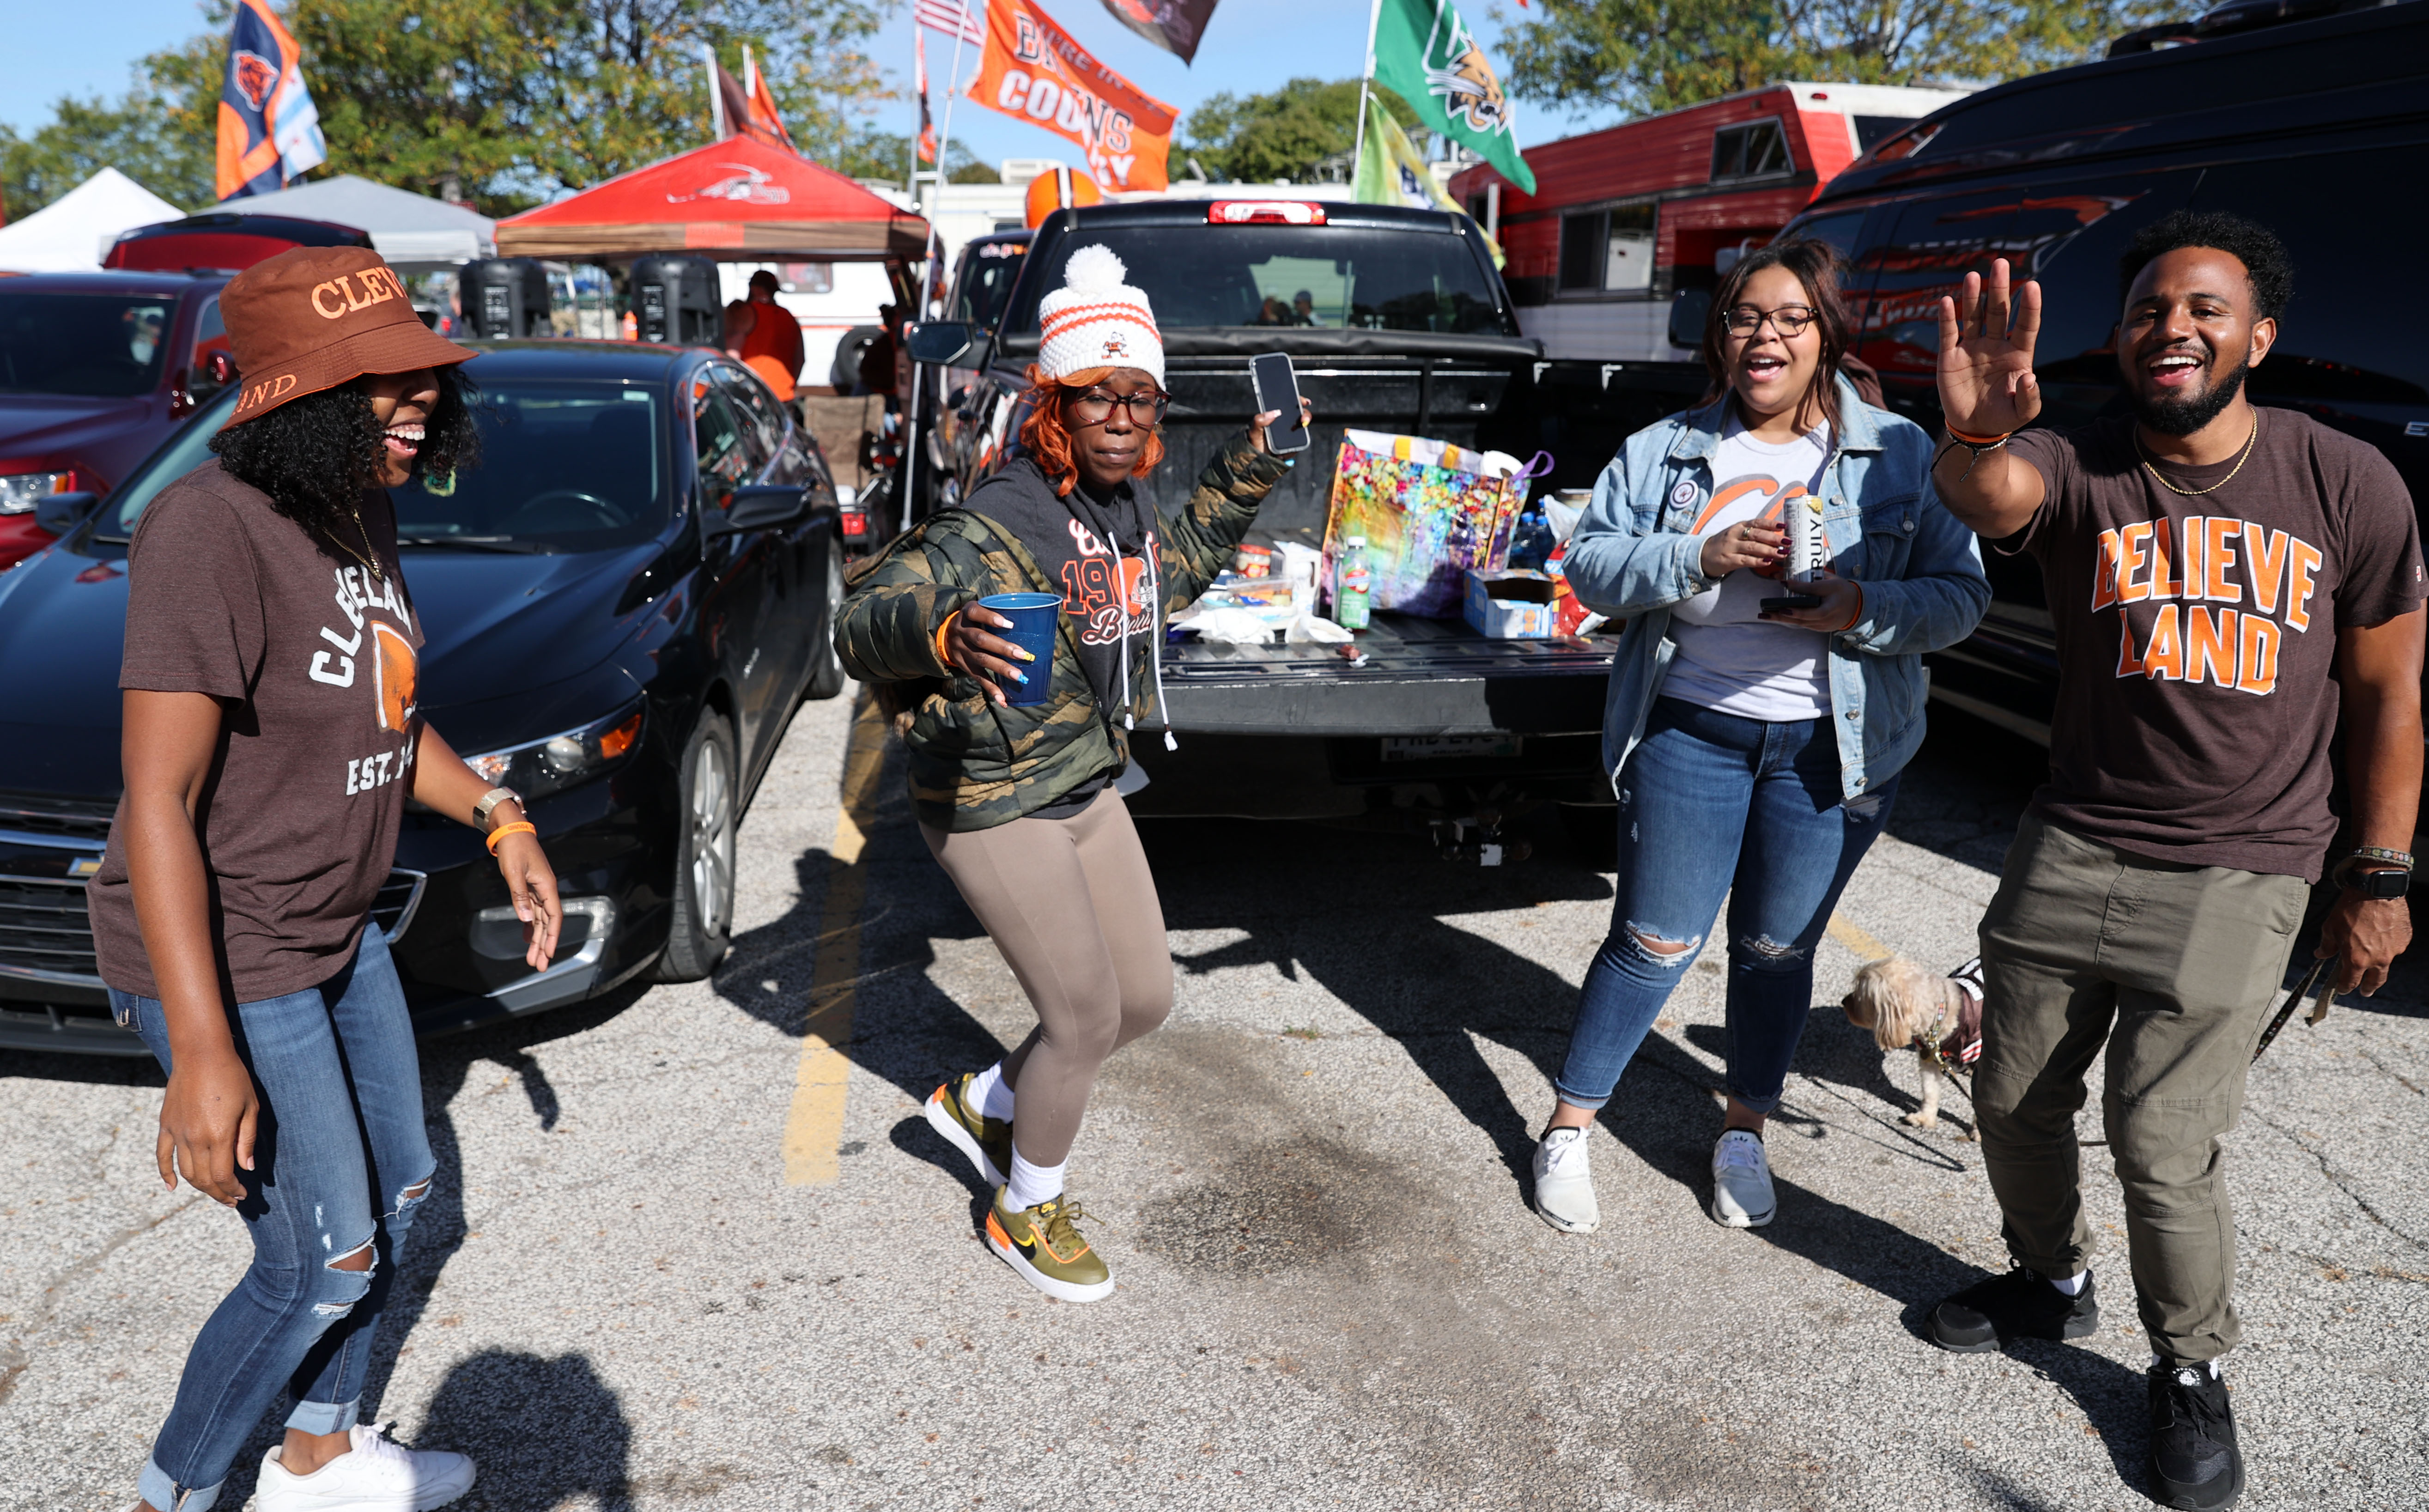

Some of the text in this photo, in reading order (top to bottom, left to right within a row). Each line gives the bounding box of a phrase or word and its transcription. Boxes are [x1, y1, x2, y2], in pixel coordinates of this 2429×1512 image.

[2091, 516, 2323, 633] BELIEVE
[2116, 604, 2282, 696] LAND
[346, 751, 393, 795] EST.
